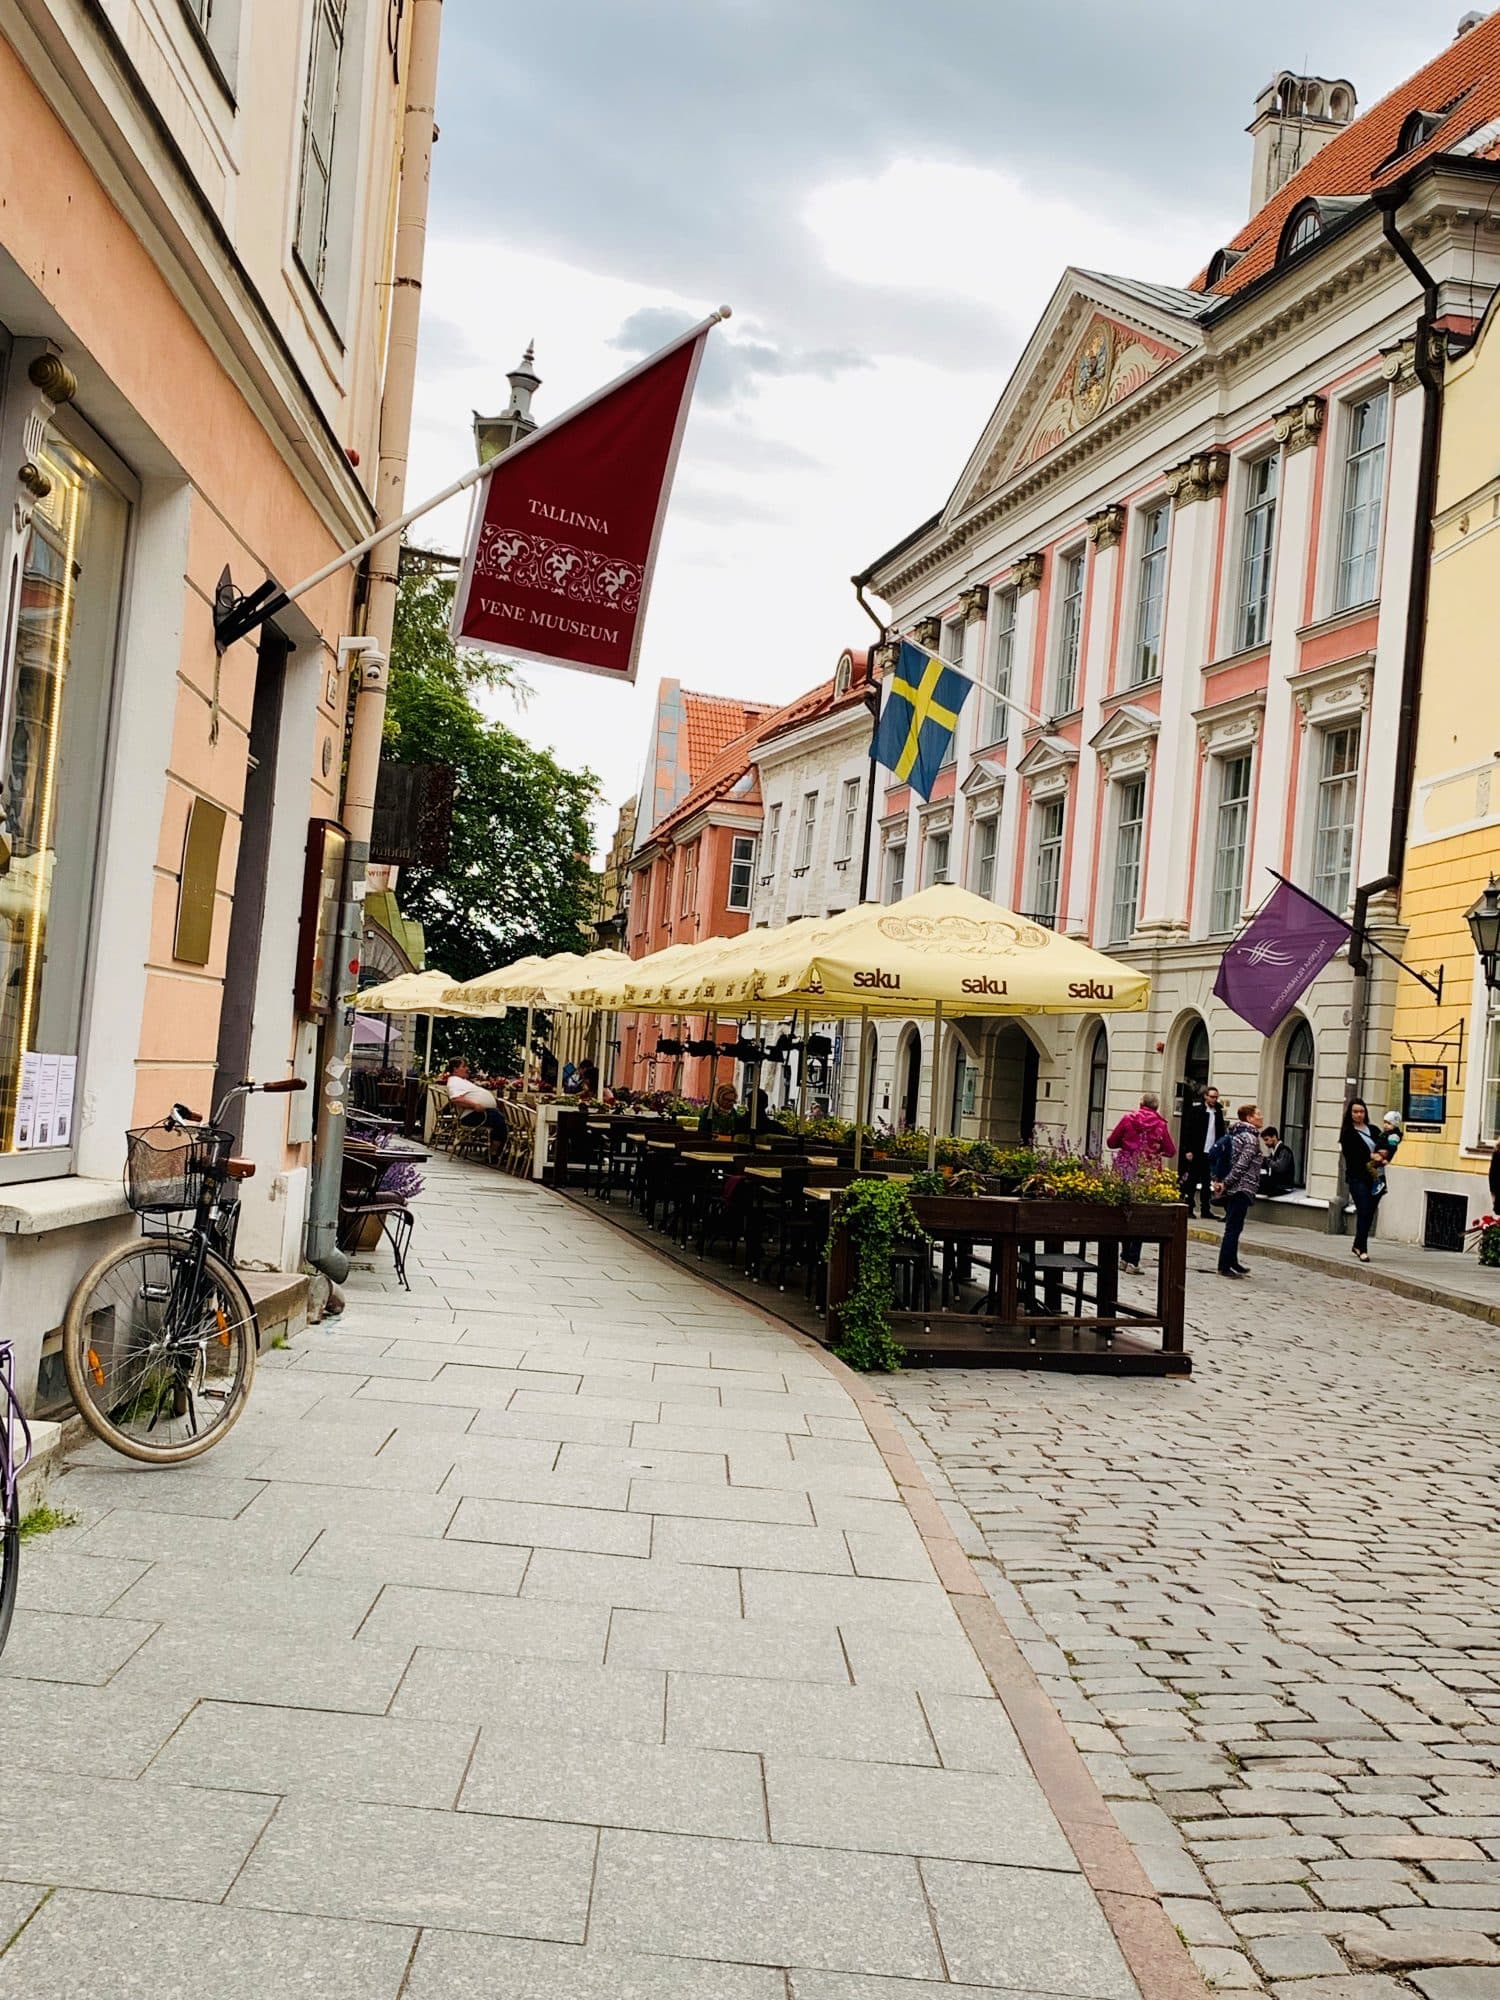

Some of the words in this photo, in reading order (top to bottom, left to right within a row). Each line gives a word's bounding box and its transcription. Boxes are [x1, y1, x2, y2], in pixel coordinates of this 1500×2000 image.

[528, 498, 609, 535] TALLINNA
[480, 597, 526, 622] VENE
[529, 610, 619, 644] MUUSEUM
[853, 968, 901, 989] saku
[961, 975, 1008, 996] saku
[1068, 979, 1113, 1000] saku
